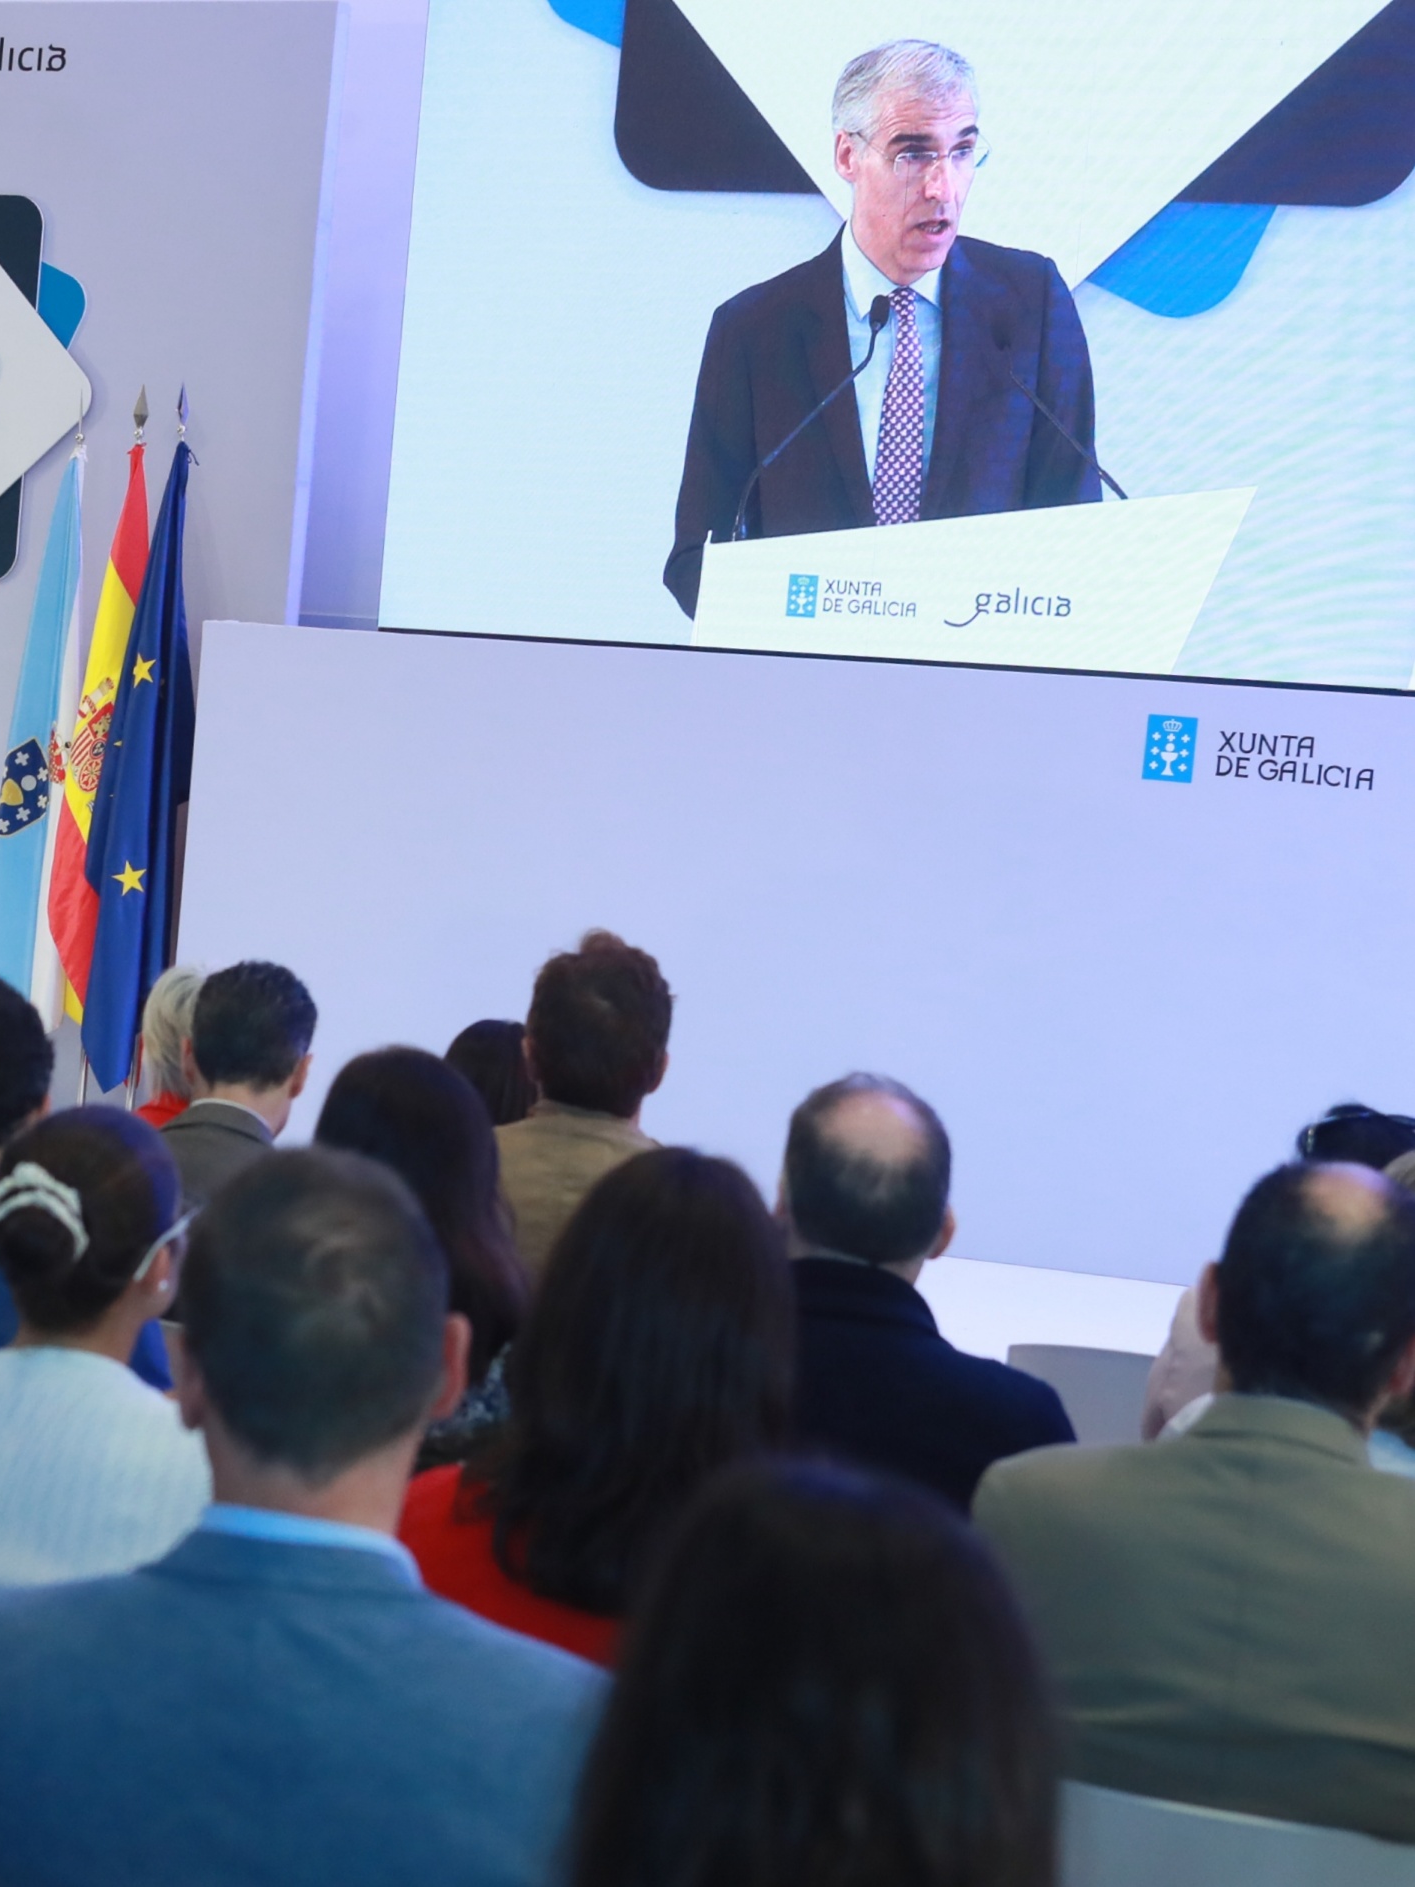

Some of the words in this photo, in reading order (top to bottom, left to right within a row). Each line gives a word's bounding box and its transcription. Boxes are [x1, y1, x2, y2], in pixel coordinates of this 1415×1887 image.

[824, 578, 883, 597] XUNTA
[821, 597, 845, 614] DE
[848, 599, 917, 618] GALICIA
[943, 586, 1072, 628] galicia
[1217, 731, 1316, 758] XUNTA
[1215, 754, 1250, 779] DE
[1257, 758, 1375, 791] GALICIA
